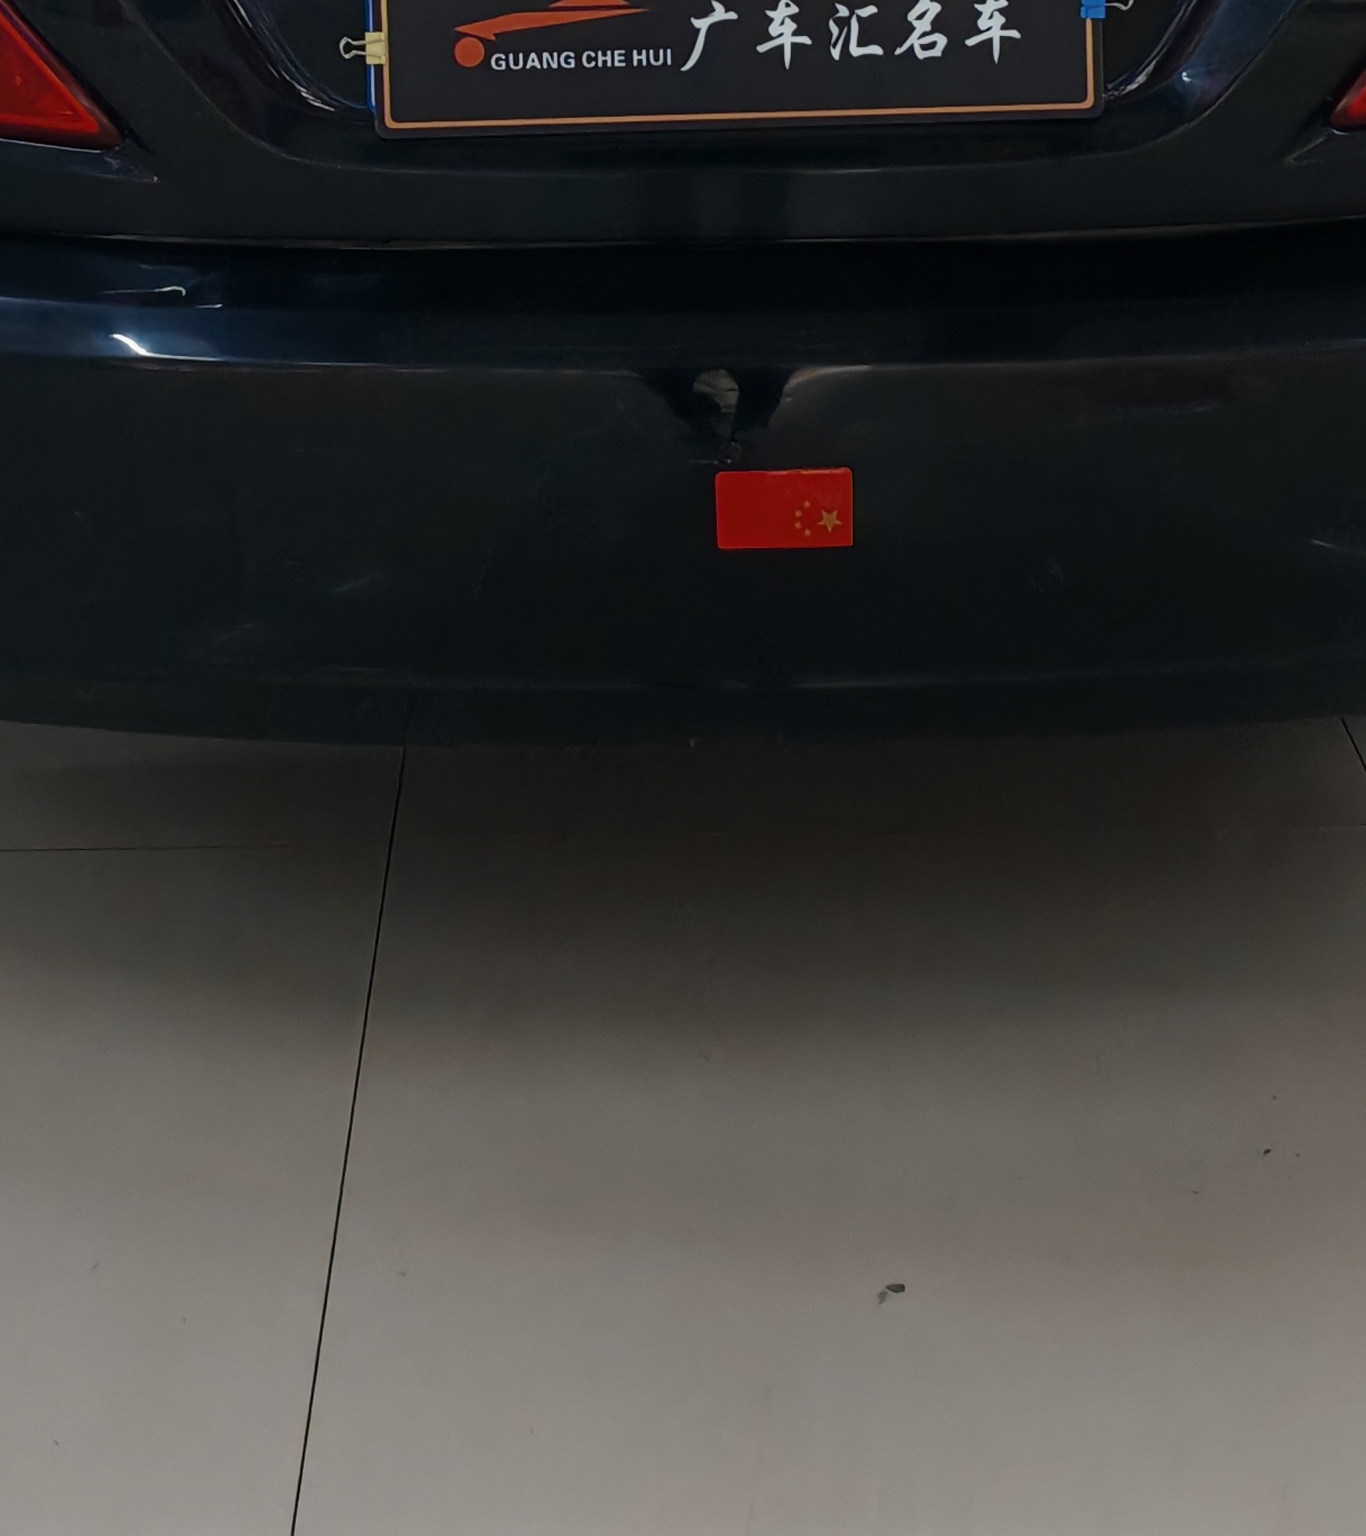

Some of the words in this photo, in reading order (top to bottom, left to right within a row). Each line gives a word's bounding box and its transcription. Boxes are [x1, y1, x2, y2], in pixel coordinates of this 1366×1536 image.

[490, 52, 576, 70] GUANG
[582, 50, 627, 68] CHE
[632, 48, 672, 67] HUI
